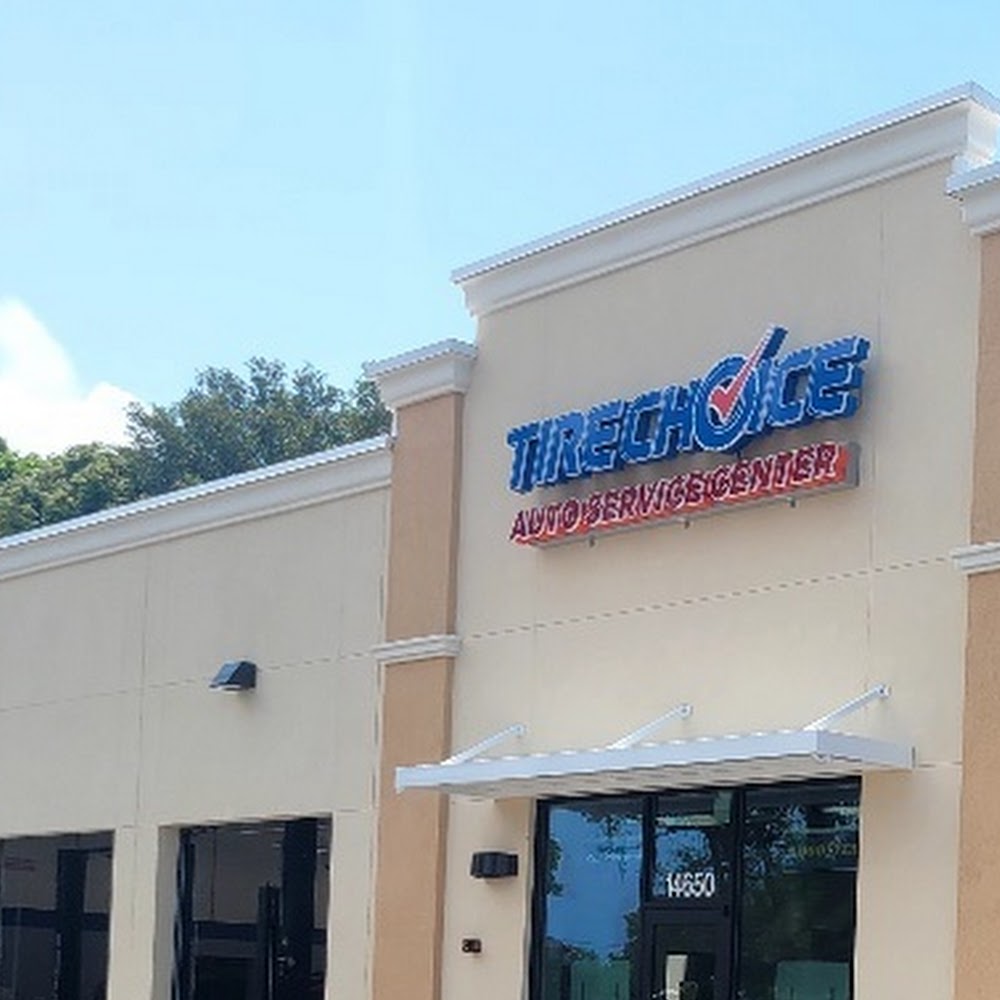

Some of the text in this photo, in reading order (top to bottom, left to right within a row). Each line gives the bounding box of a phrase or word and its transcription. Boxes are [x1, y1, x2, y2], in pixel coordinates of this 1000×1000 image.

[509, 441, 840, 542] AUTO SERVICE CENTER
[666, 871, 716, 898] 14650
